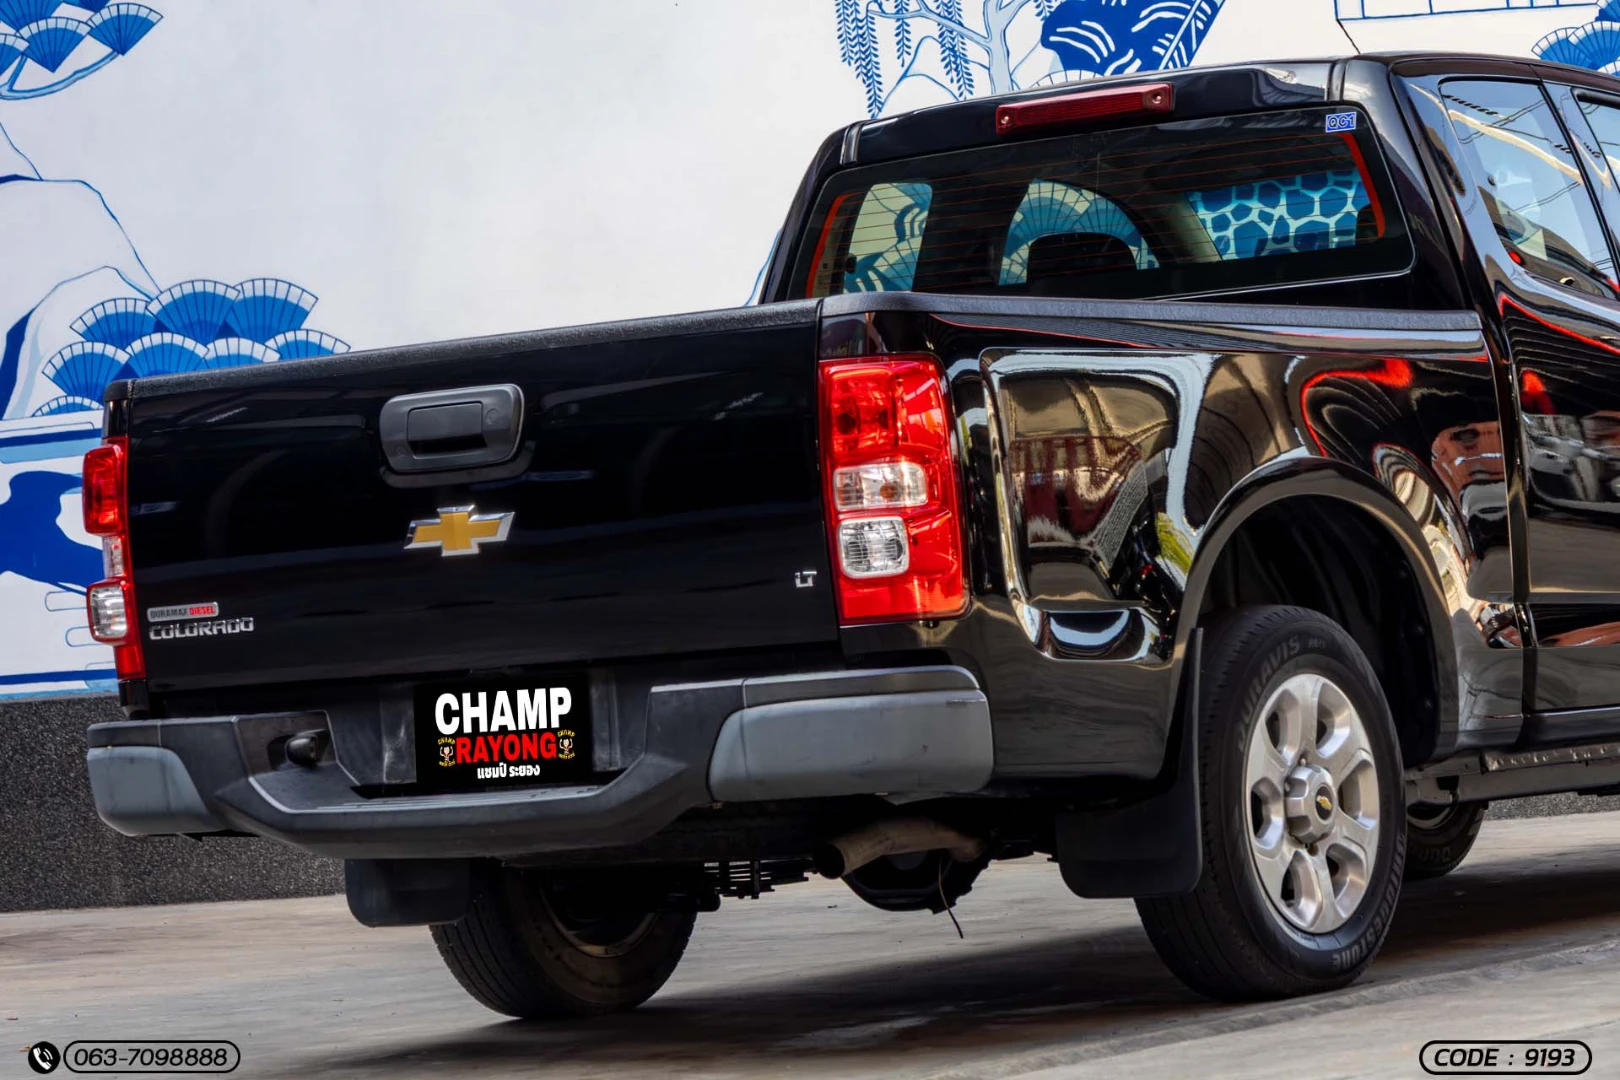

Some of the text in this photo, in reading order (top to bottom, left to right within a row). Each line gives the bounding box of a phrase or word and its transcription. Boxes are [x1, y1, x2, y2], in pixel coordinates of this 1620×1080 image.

[1328, 114, 1356, 129] QC1
[794, 571, 817, 588] LT
[149, 605, 216, 620] DURAMAX DIESEL
[149, 617, 254, 640] COLORADO
